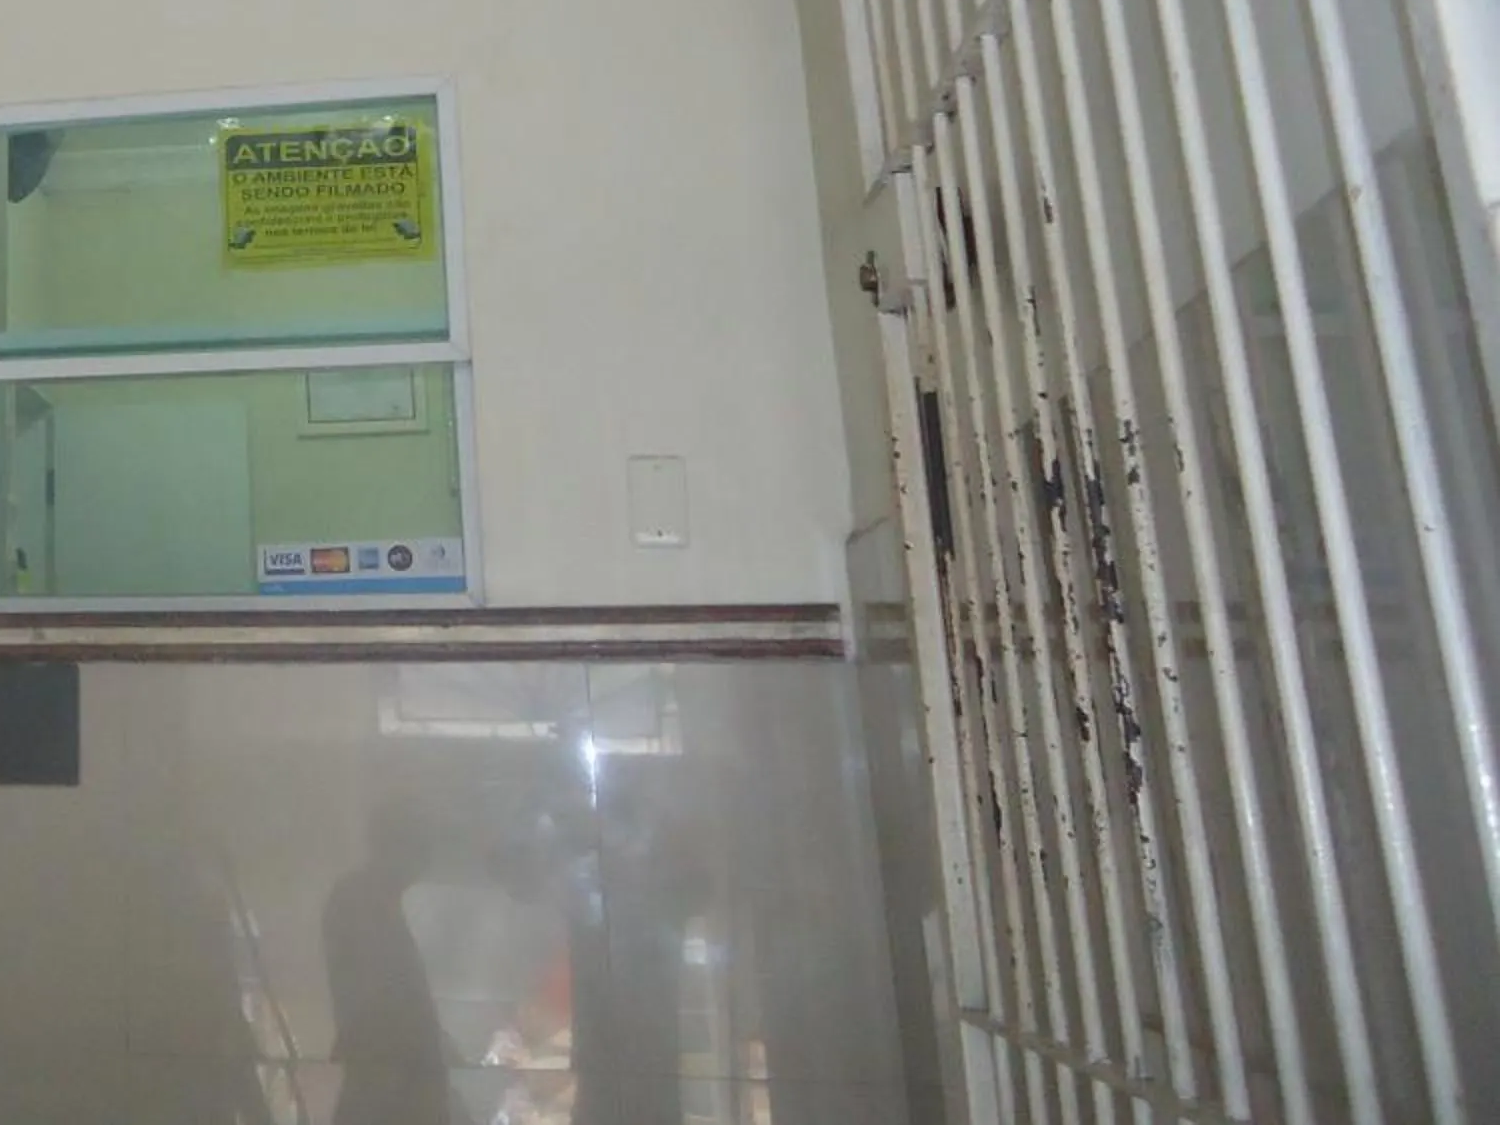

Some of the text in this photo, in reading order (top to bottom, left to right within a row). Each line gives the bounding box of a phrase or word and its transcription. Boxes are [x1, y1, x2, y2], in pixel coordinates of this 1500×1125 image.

[232, 172, 248, 185] O
[251, 167, 355, 185] AMBIENTE
[241, 182, 405, 201] SENDO FILMADO
[269, 553, 303, 566] VISA
